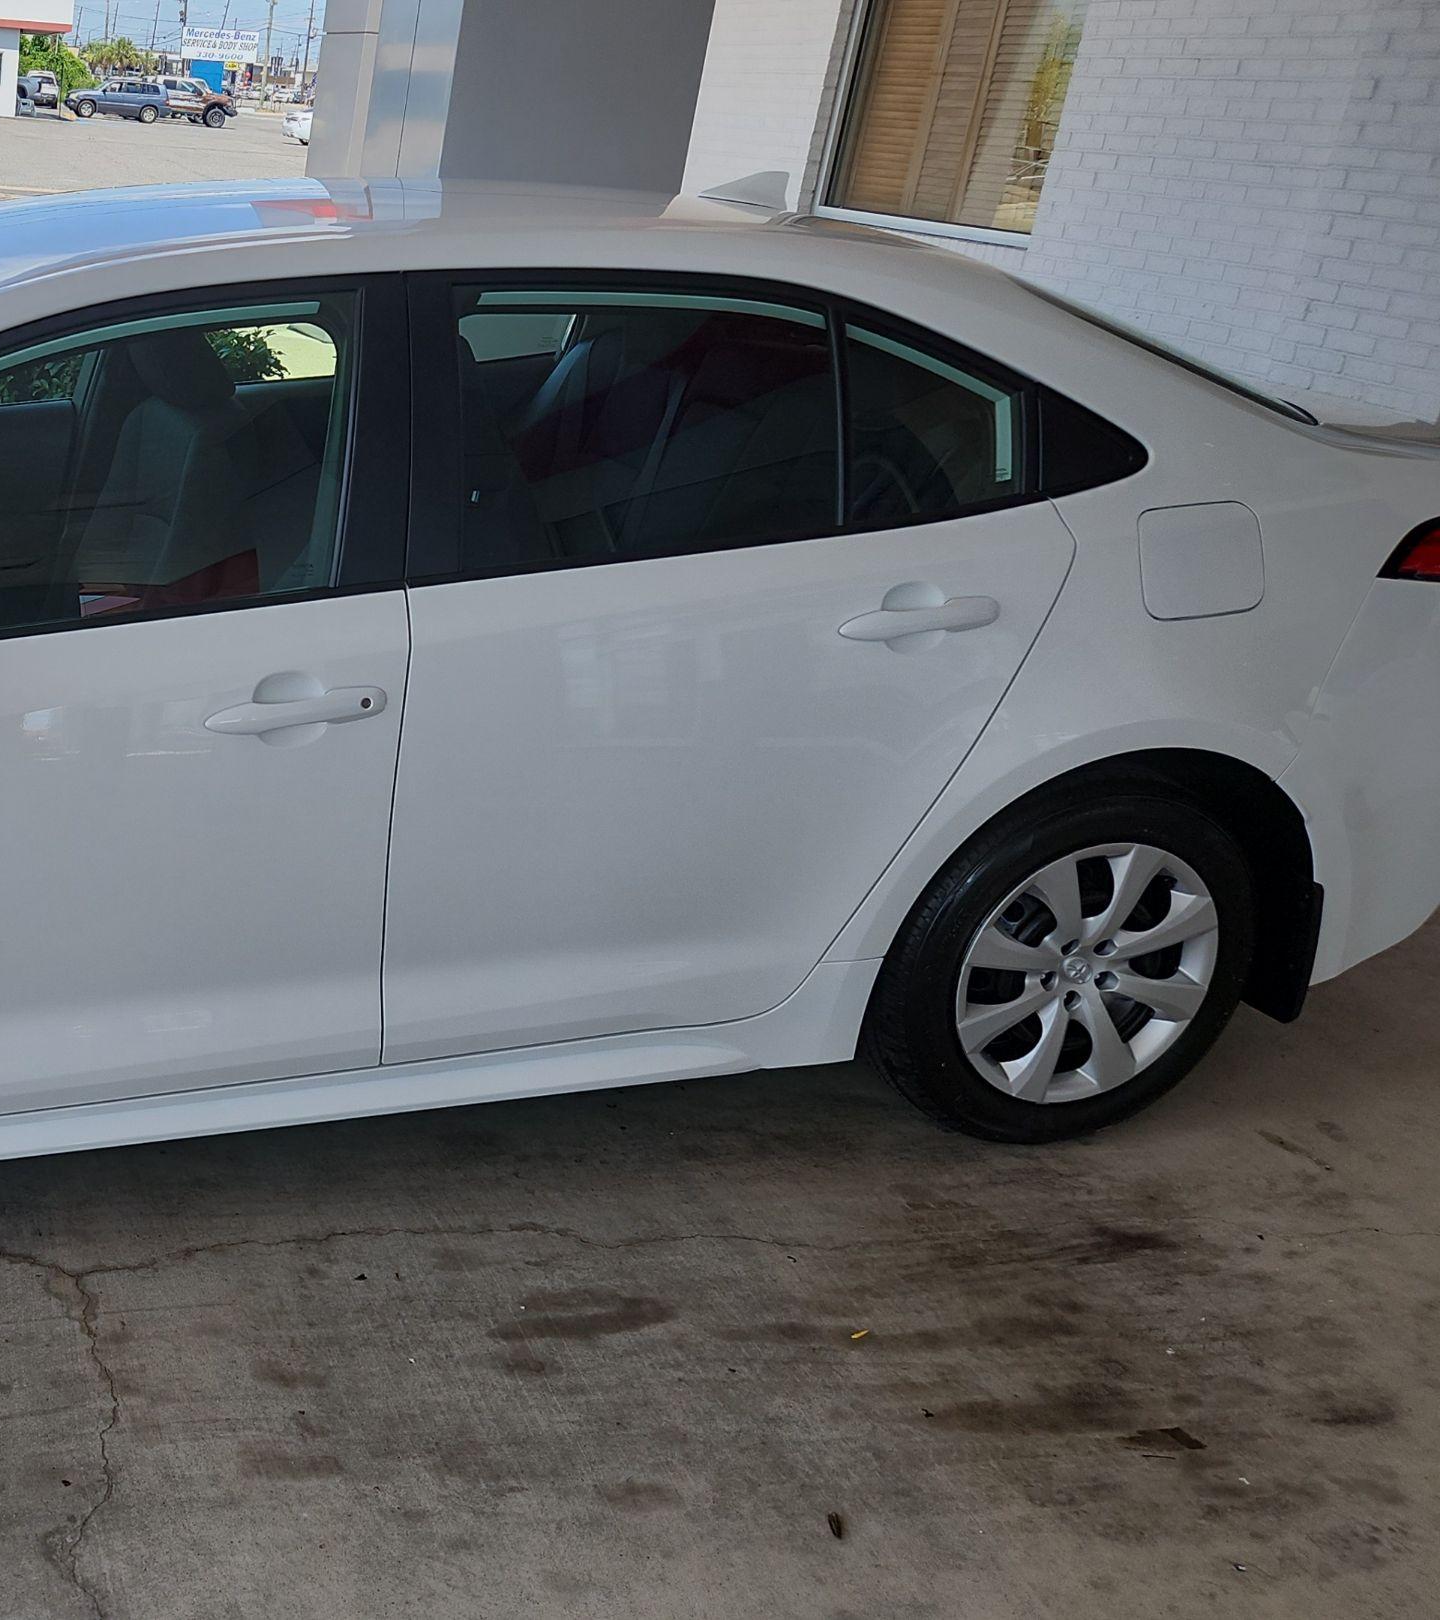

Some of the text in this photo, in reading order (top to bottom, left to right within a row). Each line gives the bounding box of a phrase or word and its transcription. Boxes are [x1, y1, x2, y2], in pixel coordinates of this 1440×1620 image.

[186, 28, 257, 41] Mercedes-Benz
[218, 41, 239, 51] BODY
[239, 42, 258, 52] SHOP
